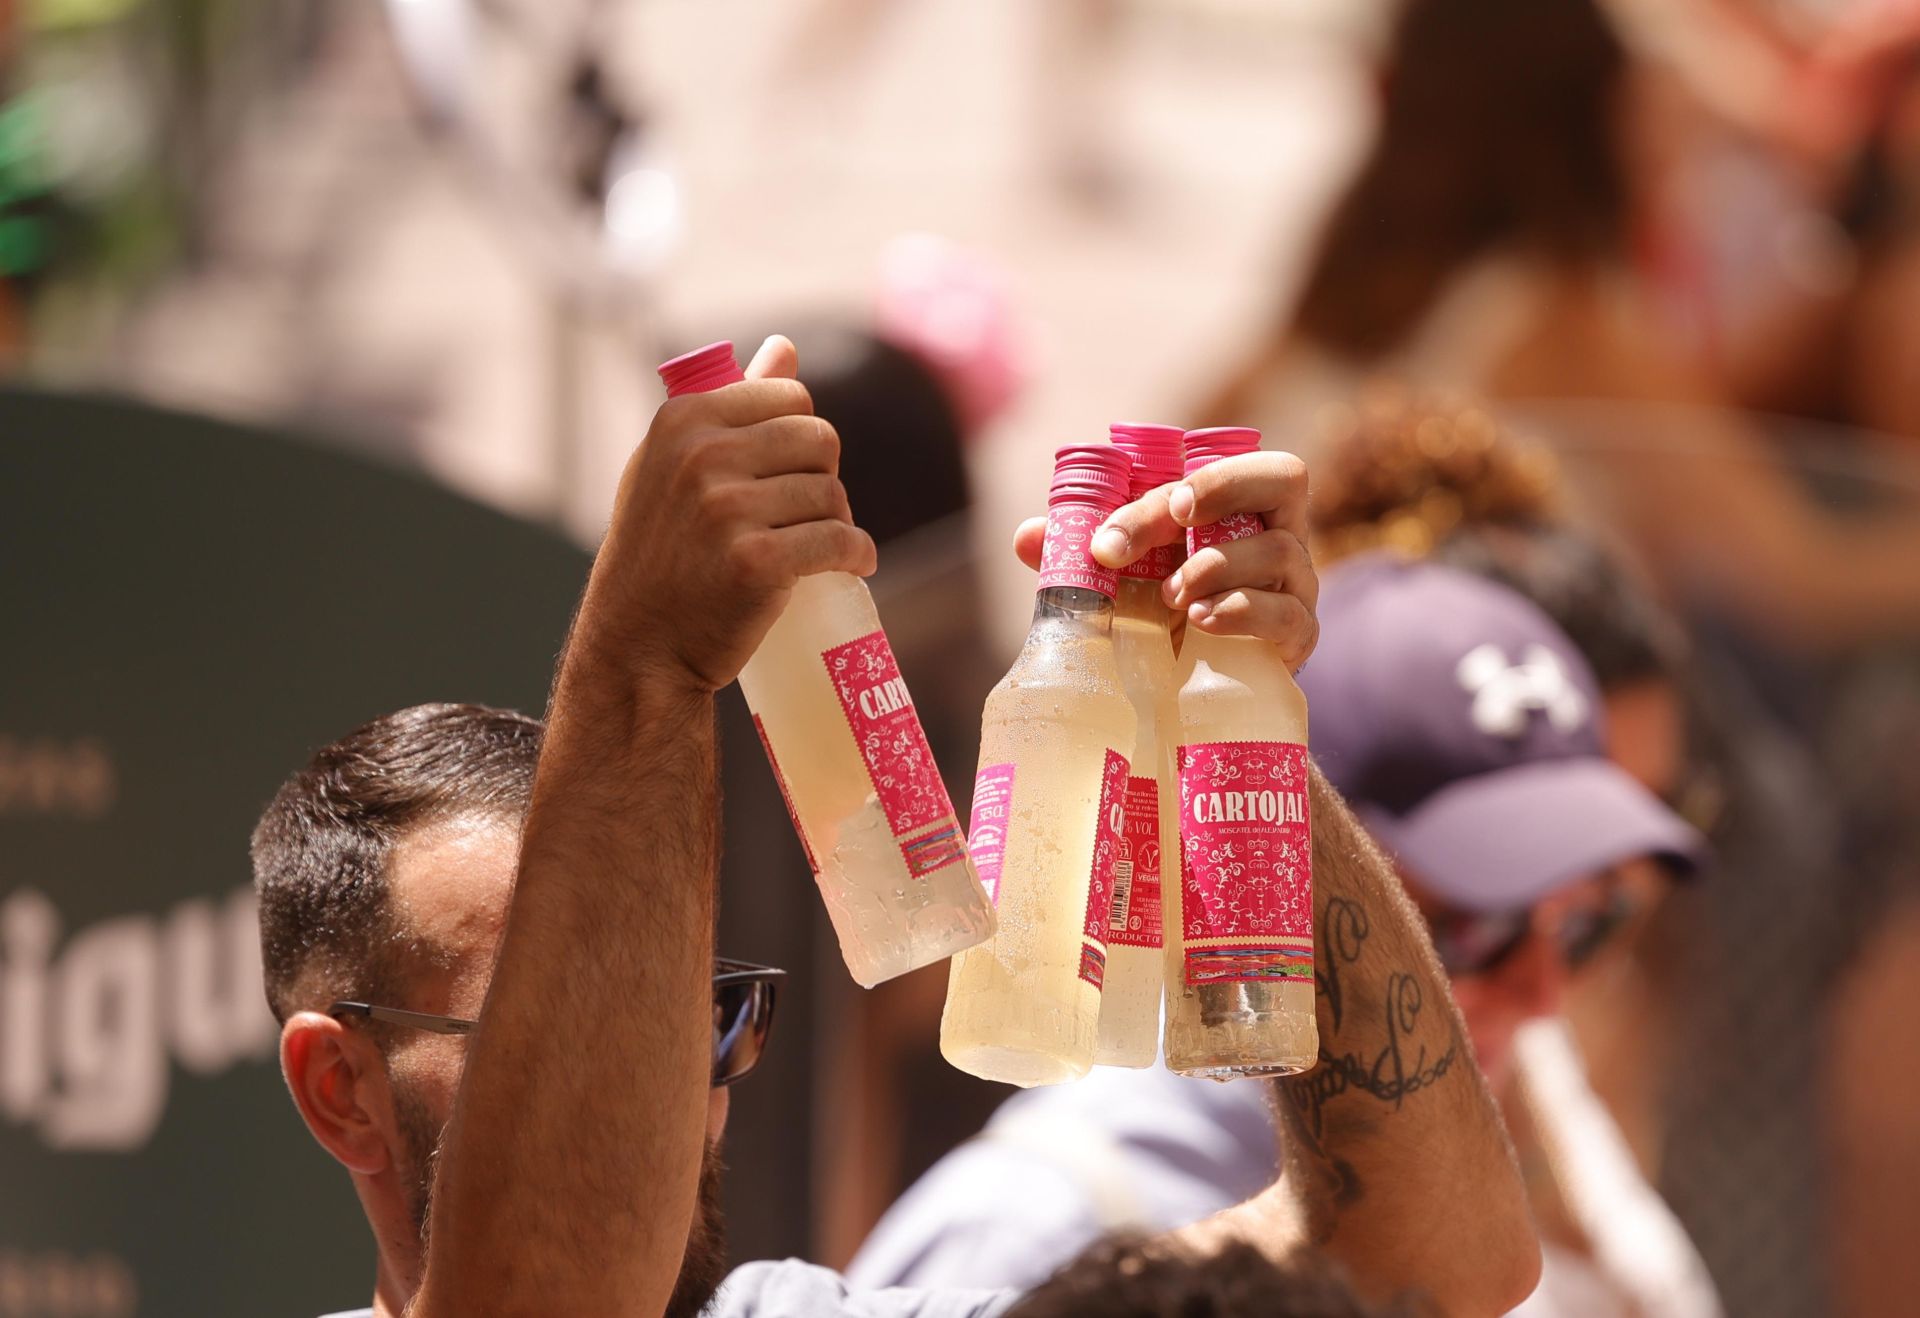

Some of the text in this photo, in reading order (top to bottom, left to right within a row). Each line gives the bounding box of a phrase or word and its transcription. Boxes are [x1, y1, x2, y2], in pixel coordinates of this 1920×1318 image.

[1070, 573, 1096, 586] MUY
[1193, 789, 1305, 826] CARTOJAL
[1137, 873, 1160, 883] VEGAN
